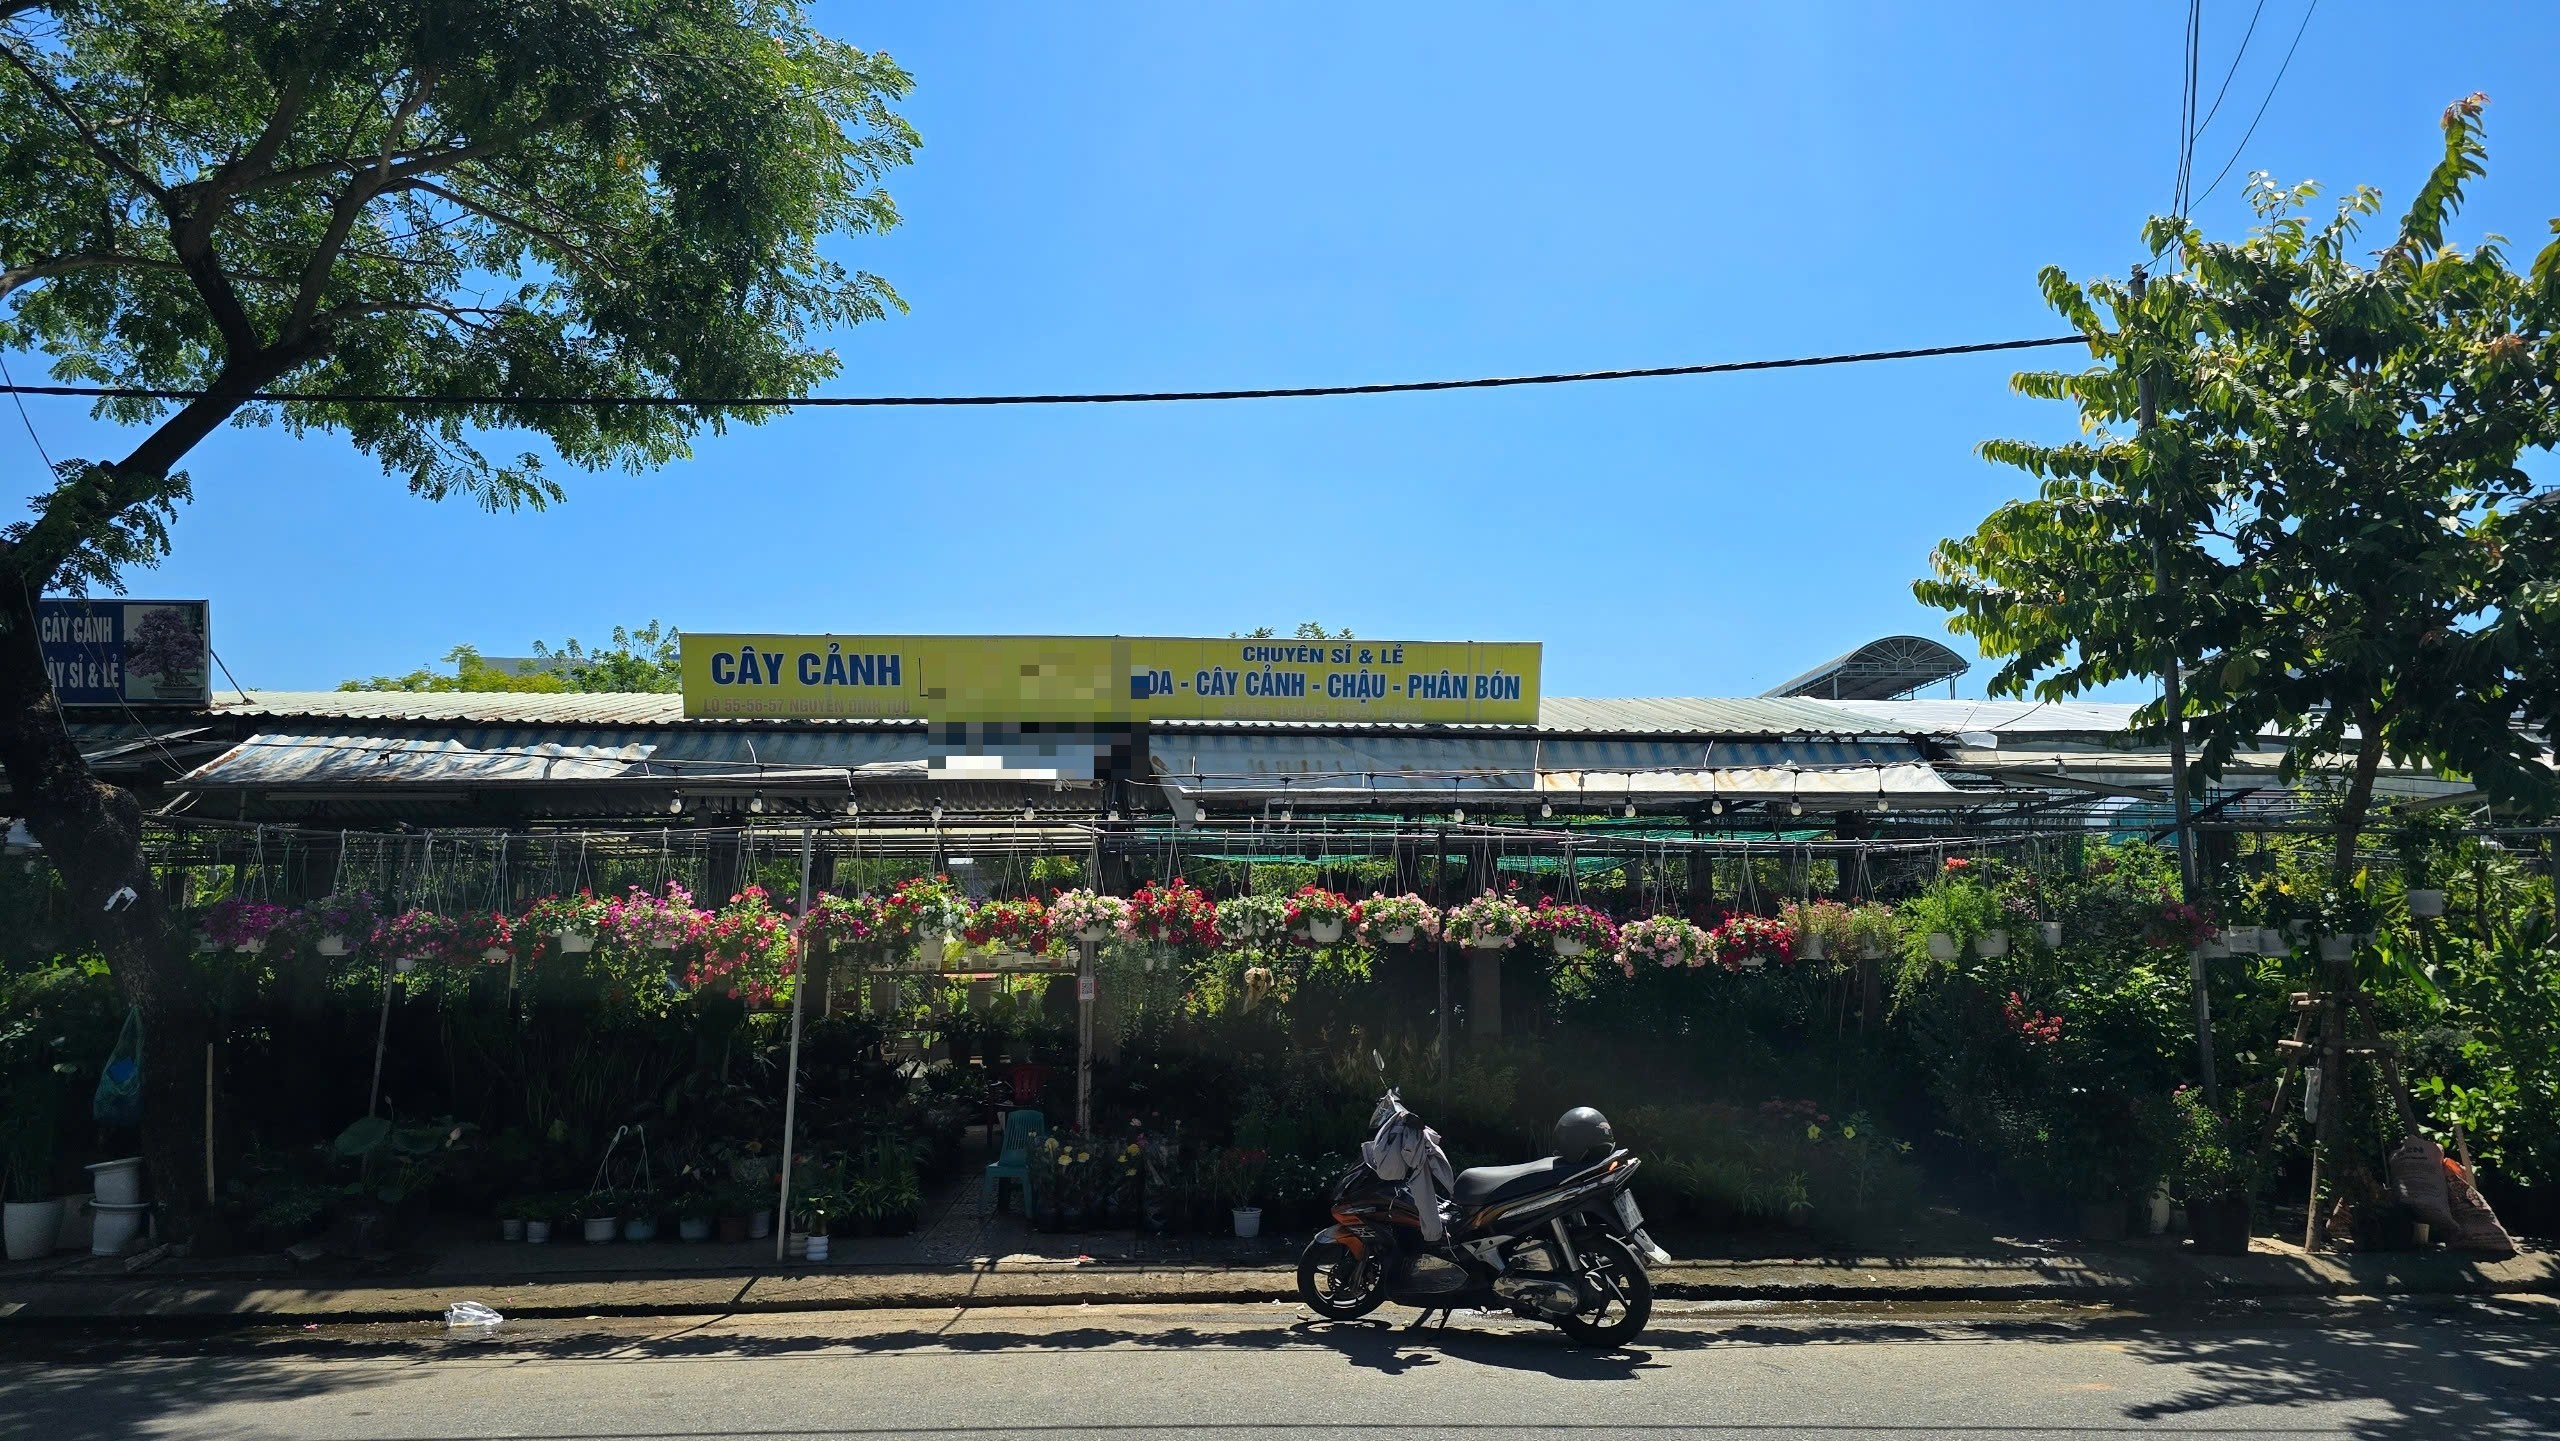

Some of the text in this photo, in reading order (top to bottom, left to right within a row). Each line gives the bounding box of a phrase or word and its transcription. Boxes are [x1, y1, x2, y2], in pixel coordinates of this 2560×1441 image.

[41, 608, 113, 643] CÂY CẢNH
[48, 653, 120, 689] ÂY SỈ & LẺ
[711, 642, 901, 687] CÂY CẢNH
[1242, 643, 1404, 664] CHUYÊN SỈ & LẺ
[1149, 670, 1174, 695] OA
[1196, 666, 1239, 696] CÂY
[1245, 664, 1305, 697] CẢNH
[1327, 669, 1386, 704] CHẬU
[1408, 669, 1468, 699] PHÂN
[1474, 670, 1520, 700] BÓN
